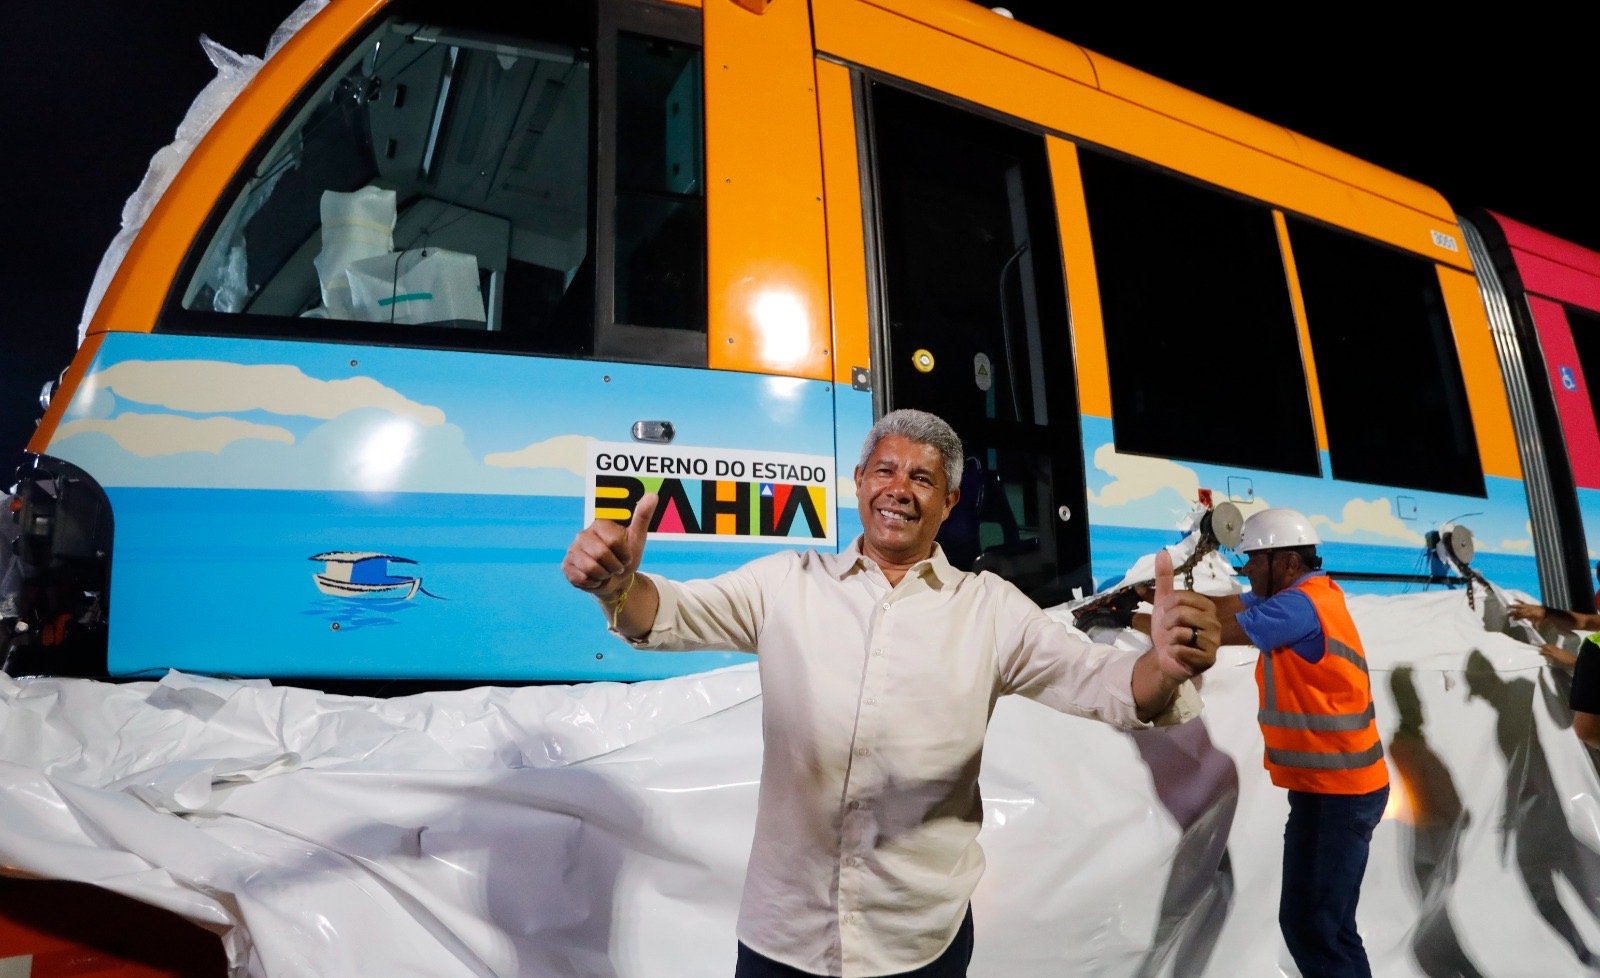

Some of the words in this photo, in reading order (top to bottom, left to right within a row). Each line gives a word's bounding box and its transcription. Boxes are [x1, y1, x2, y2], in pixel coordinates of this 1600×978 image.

[596, 453, 708, 475] GOVERNO
[715, 459, 745, 477] DO
[752, 462, 826, 483] ESTADO
[595, 475, 827, 539] BAHIA
